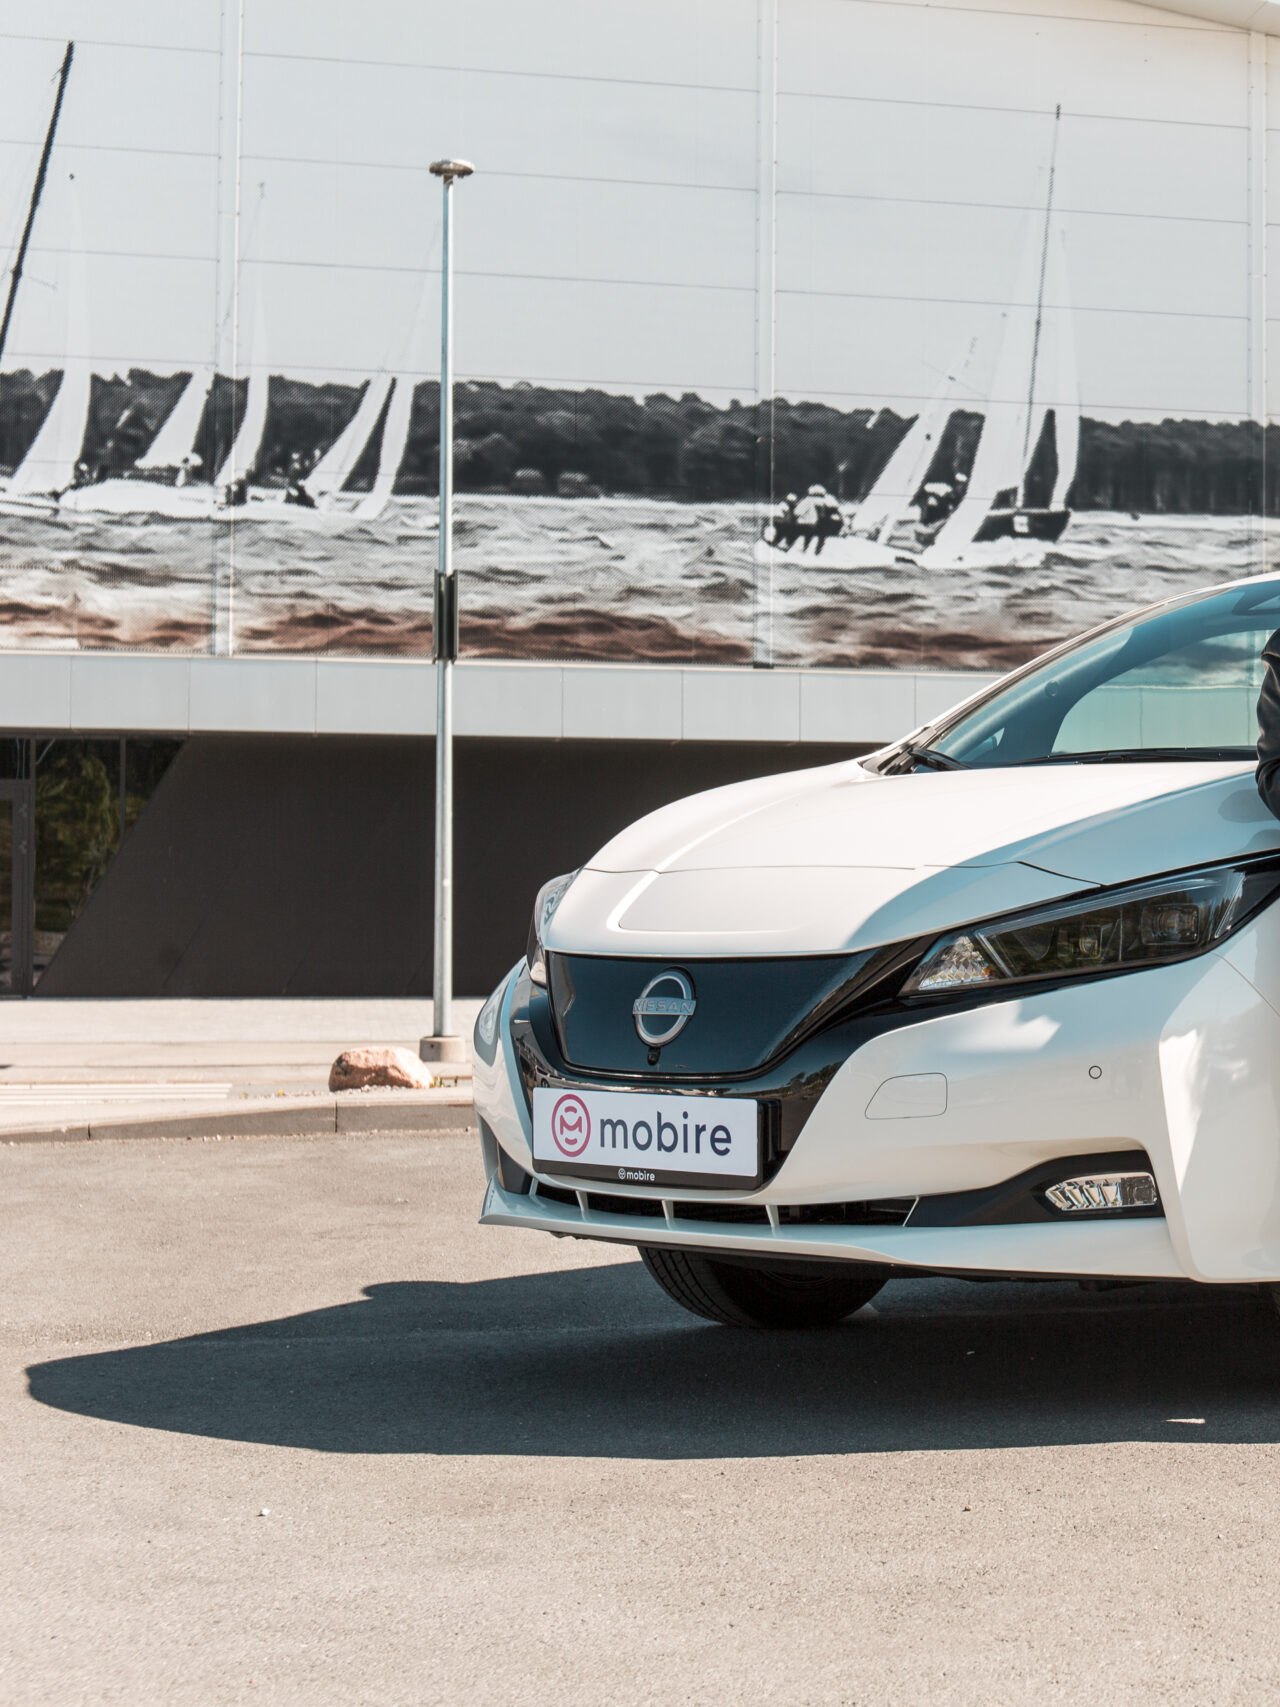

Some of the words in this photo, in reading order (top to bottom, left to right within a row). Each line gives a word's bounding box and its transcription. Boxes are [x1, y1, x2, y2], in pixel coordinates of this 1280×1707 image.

[633, 1000, 693, 1013] NISSAN
[600, 1110, 732, 1157] mobire
[626, 1170, 656, 1181] mobire
